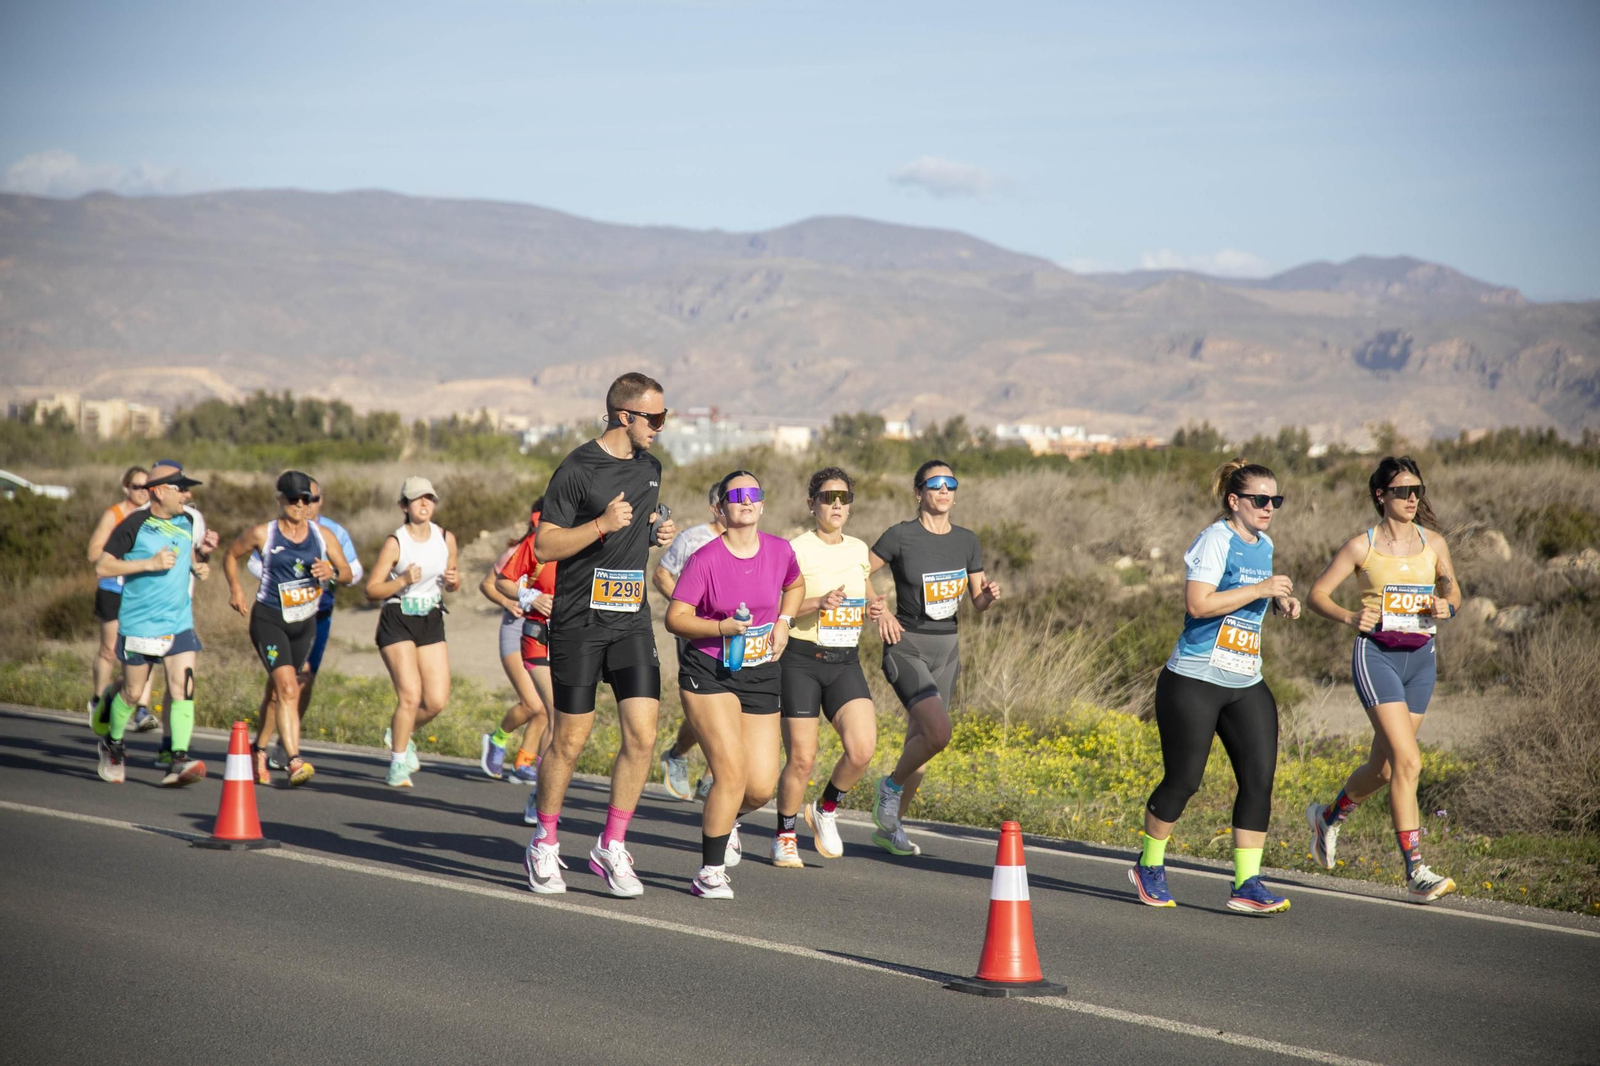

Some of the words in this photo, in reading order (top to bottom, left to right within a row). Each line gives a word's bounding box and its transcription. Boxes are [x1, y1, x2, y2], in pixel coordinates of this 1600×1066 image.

[601, 580, 641, 598] 1298
[930, 578, 964, 597] 1531
[826, 607, 861, 623] 1530
[744, 633, 768, 654] 297
